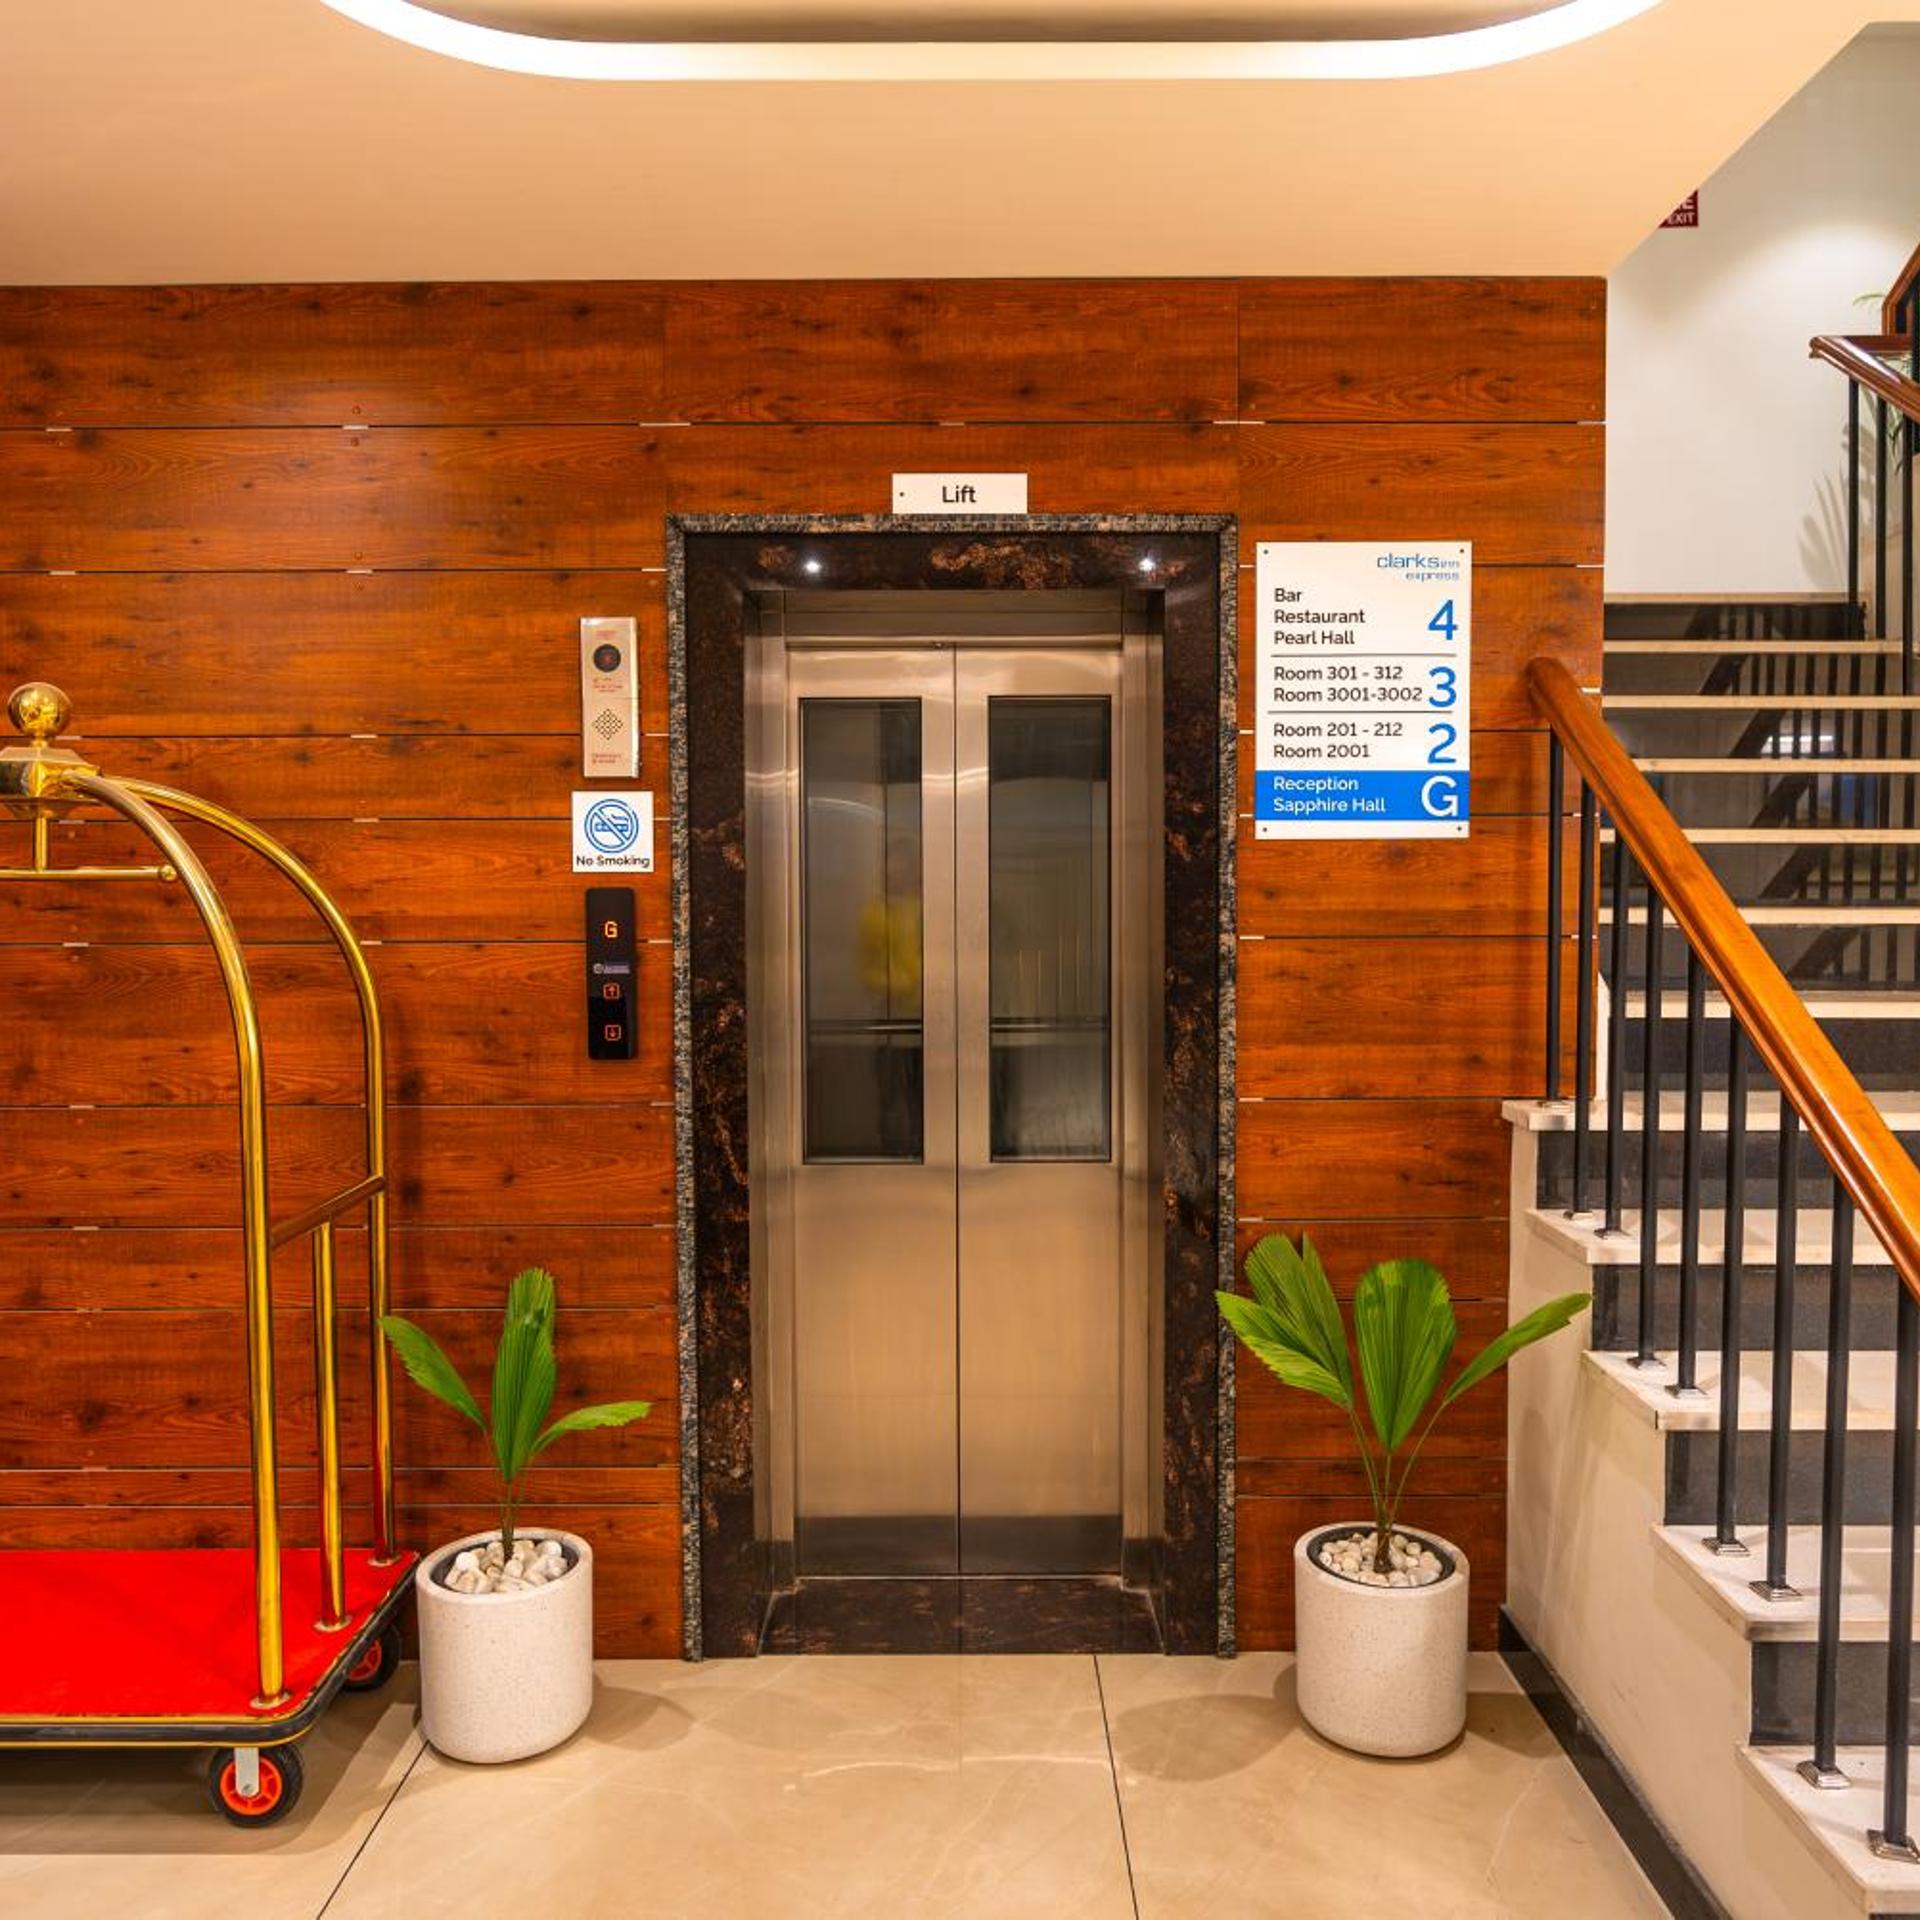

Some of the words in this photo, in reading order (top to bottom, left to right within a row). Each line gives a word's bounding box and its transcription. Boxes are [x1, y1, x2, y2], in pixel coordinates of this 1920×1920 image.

[942, 485, 977, 503] Lift
[1405, 572, 1460, 582] express
[1274, 588, 1302, 602] Bar
[1274, 609, 1366, 624] Restaurant
[1427, 599, 1459, 640] 4
[1274, 630, 1317, 644] Pearl
[1321, 630, 1355, 644] Hall
[1273, 666, 1323, 680] Room
[1327, 666, 1357, 680] 301
[1374, 666, 1403, 680] 312
[1428, 666, 1457, 707] 3
[1273, 687, 1323, 702] Room
[1327, 687, 1423, 702] 3001-3002
[1273, 722, 1322, 737] Room
[1327, 722, 1357, 737] 201
[1374, 722, 1403, 737] 212
[1427, 722, 1457, 764] 2
[1273, 744, 1322, 758] Room
[1327, 744, 1370, 758] 2001
[1273, 776, 1359, 793] Reception
[1421, 775, 1459, 817] G
[1273, 797, 1348, 815] Sapphire
[1352, 797, 1386, 812] Hall
[576, 855, 594, 866] No
[596, 854, 650, 868] Smoking
[605, 921, 618, 937] G
